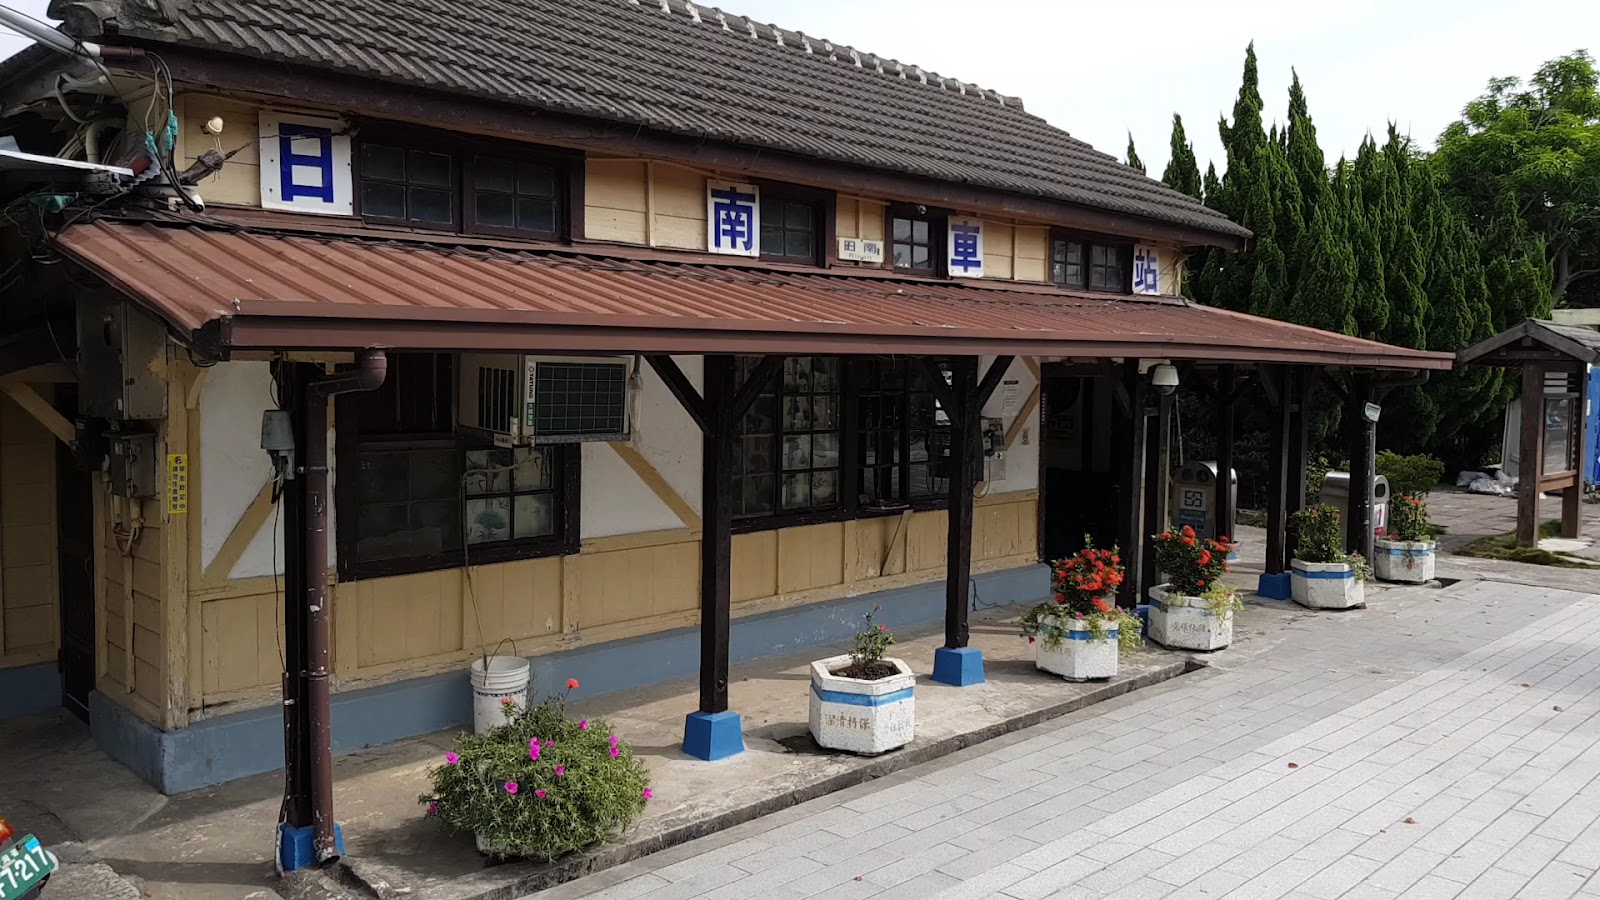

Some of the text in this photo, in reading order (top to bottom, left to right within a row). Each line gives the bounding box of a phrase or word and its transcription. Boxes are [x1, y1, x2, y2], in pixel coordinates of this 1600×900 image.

[279, 122, 1157, 293] 日 南 車 站
